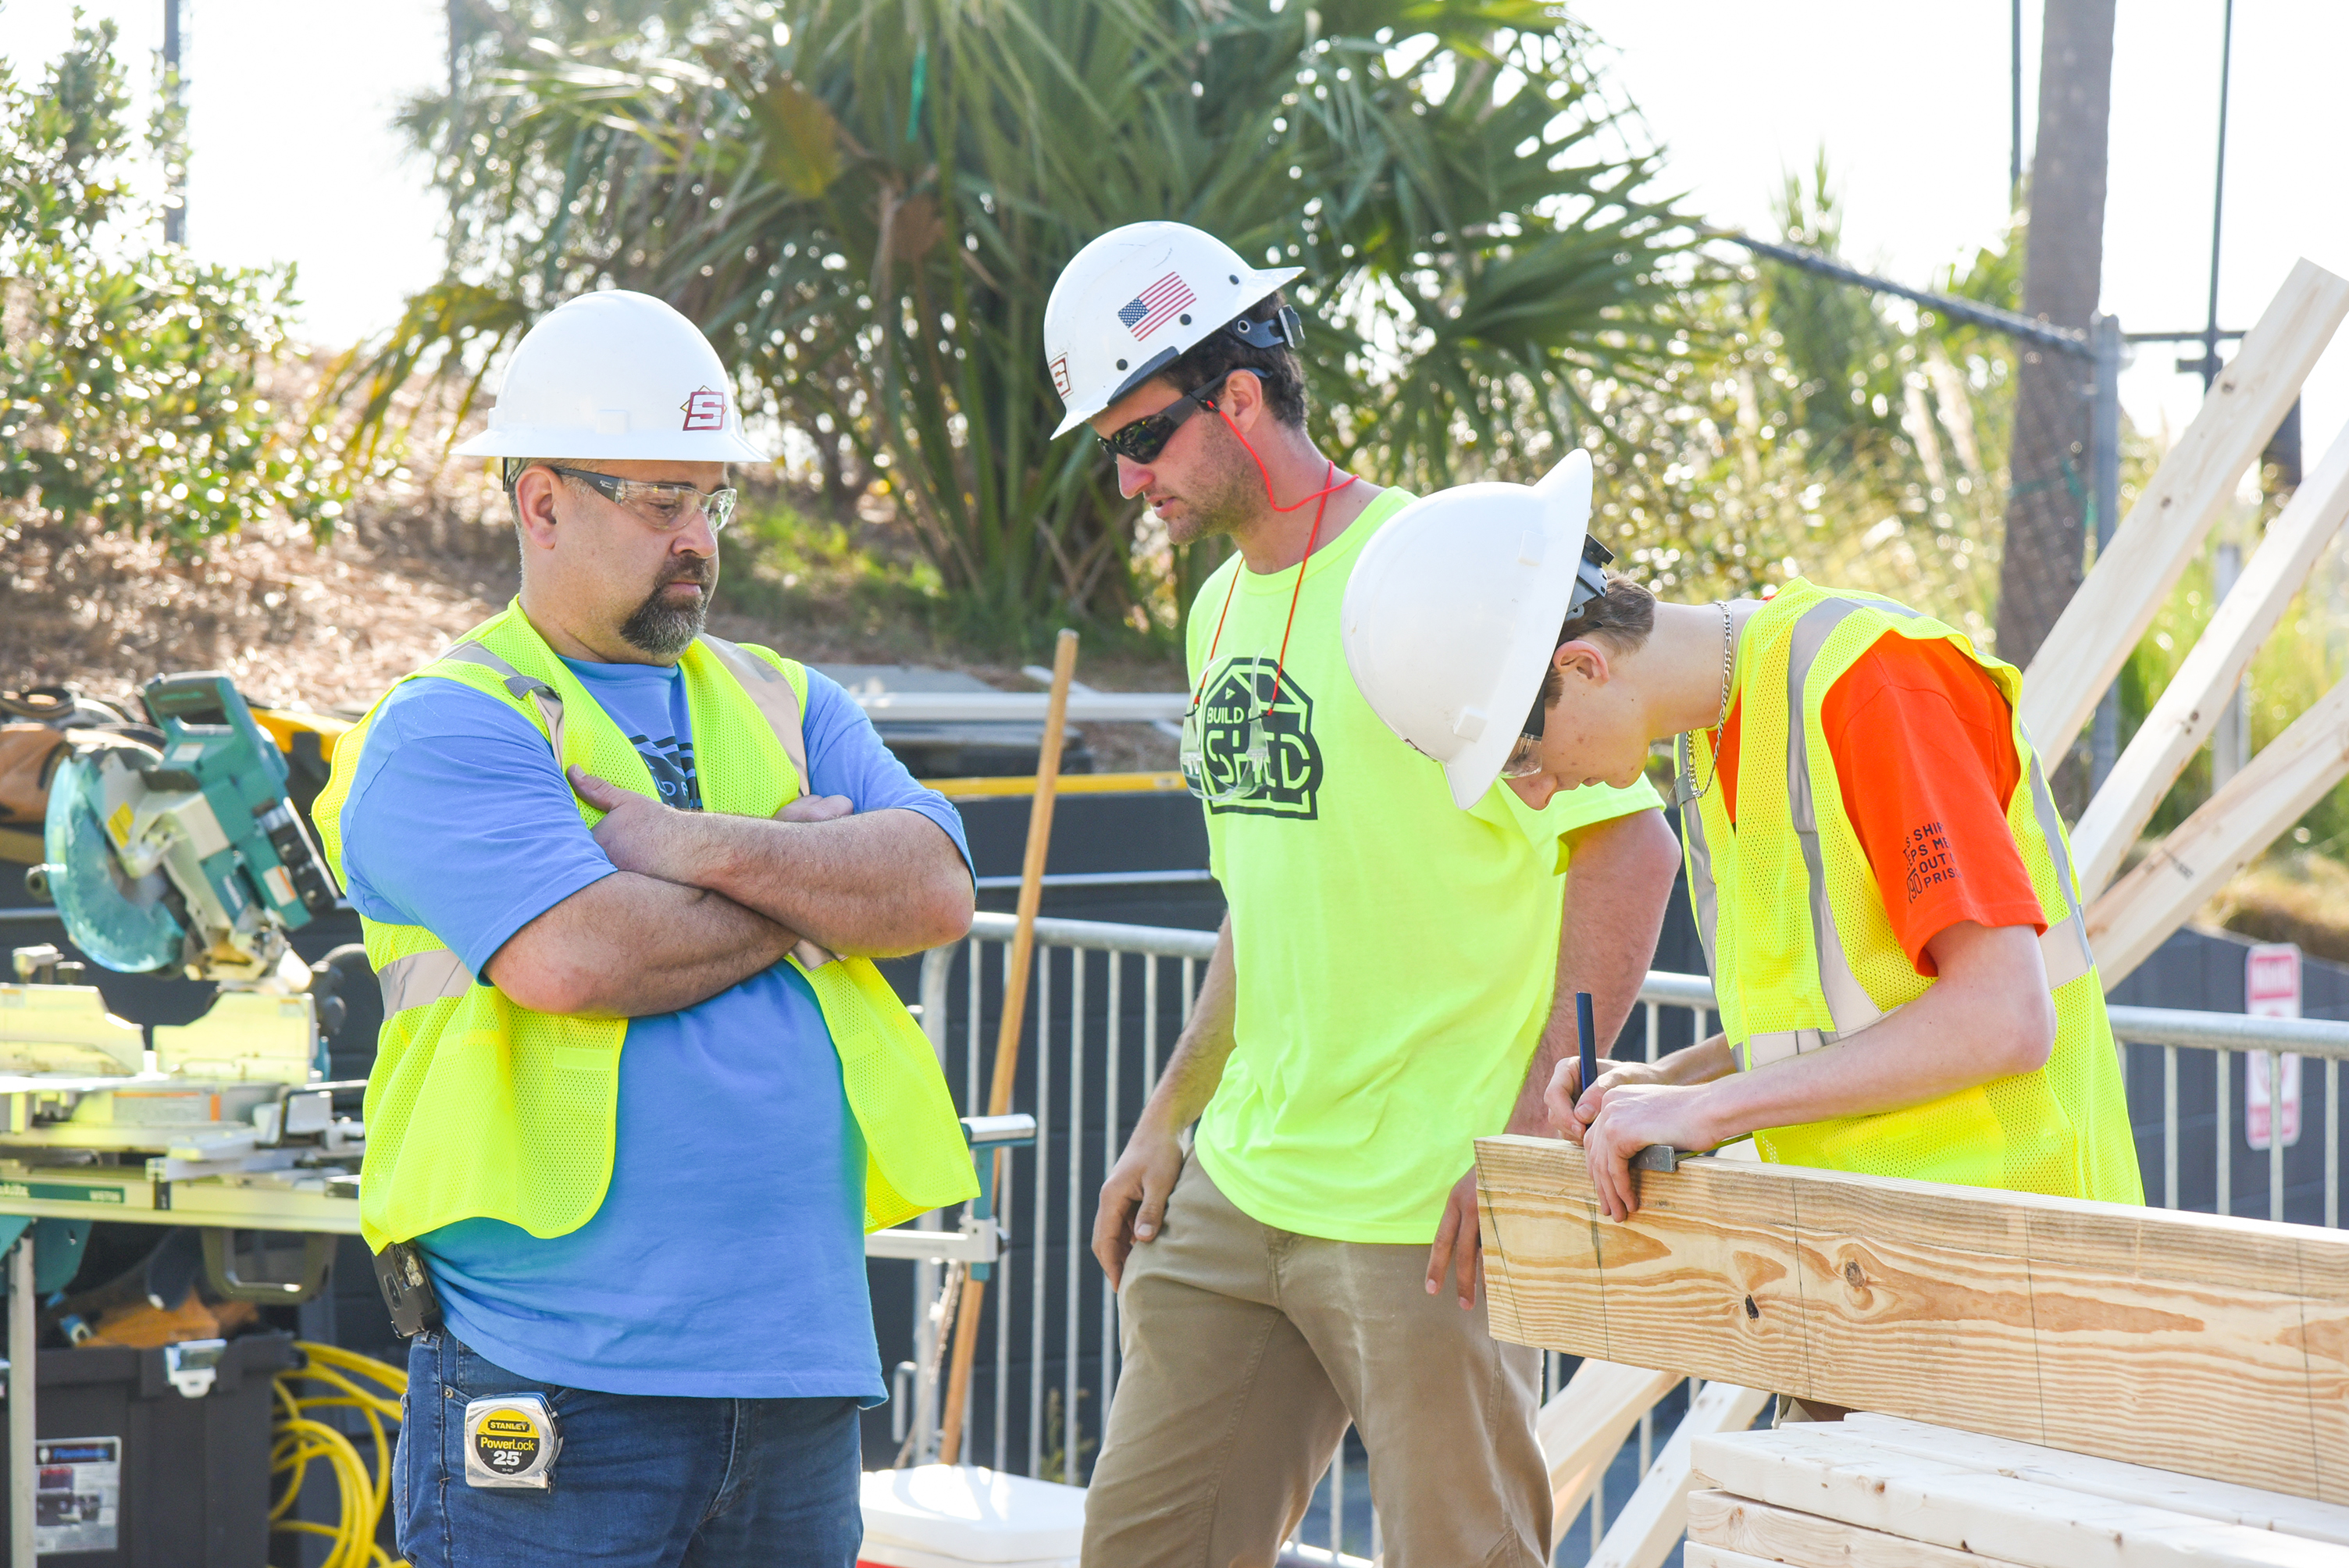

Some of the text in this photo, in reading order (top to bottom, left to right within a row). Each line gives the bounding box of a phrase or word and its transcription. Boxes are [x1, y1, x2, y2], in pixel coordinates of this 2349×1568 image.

[1207, 707, 1245, 724] BUILD
[1919, 853, 1946, 874] OUT
[490, 1422, 527, 1431] STANLEY
[480, 1437, 534, 1451] PowerLock
